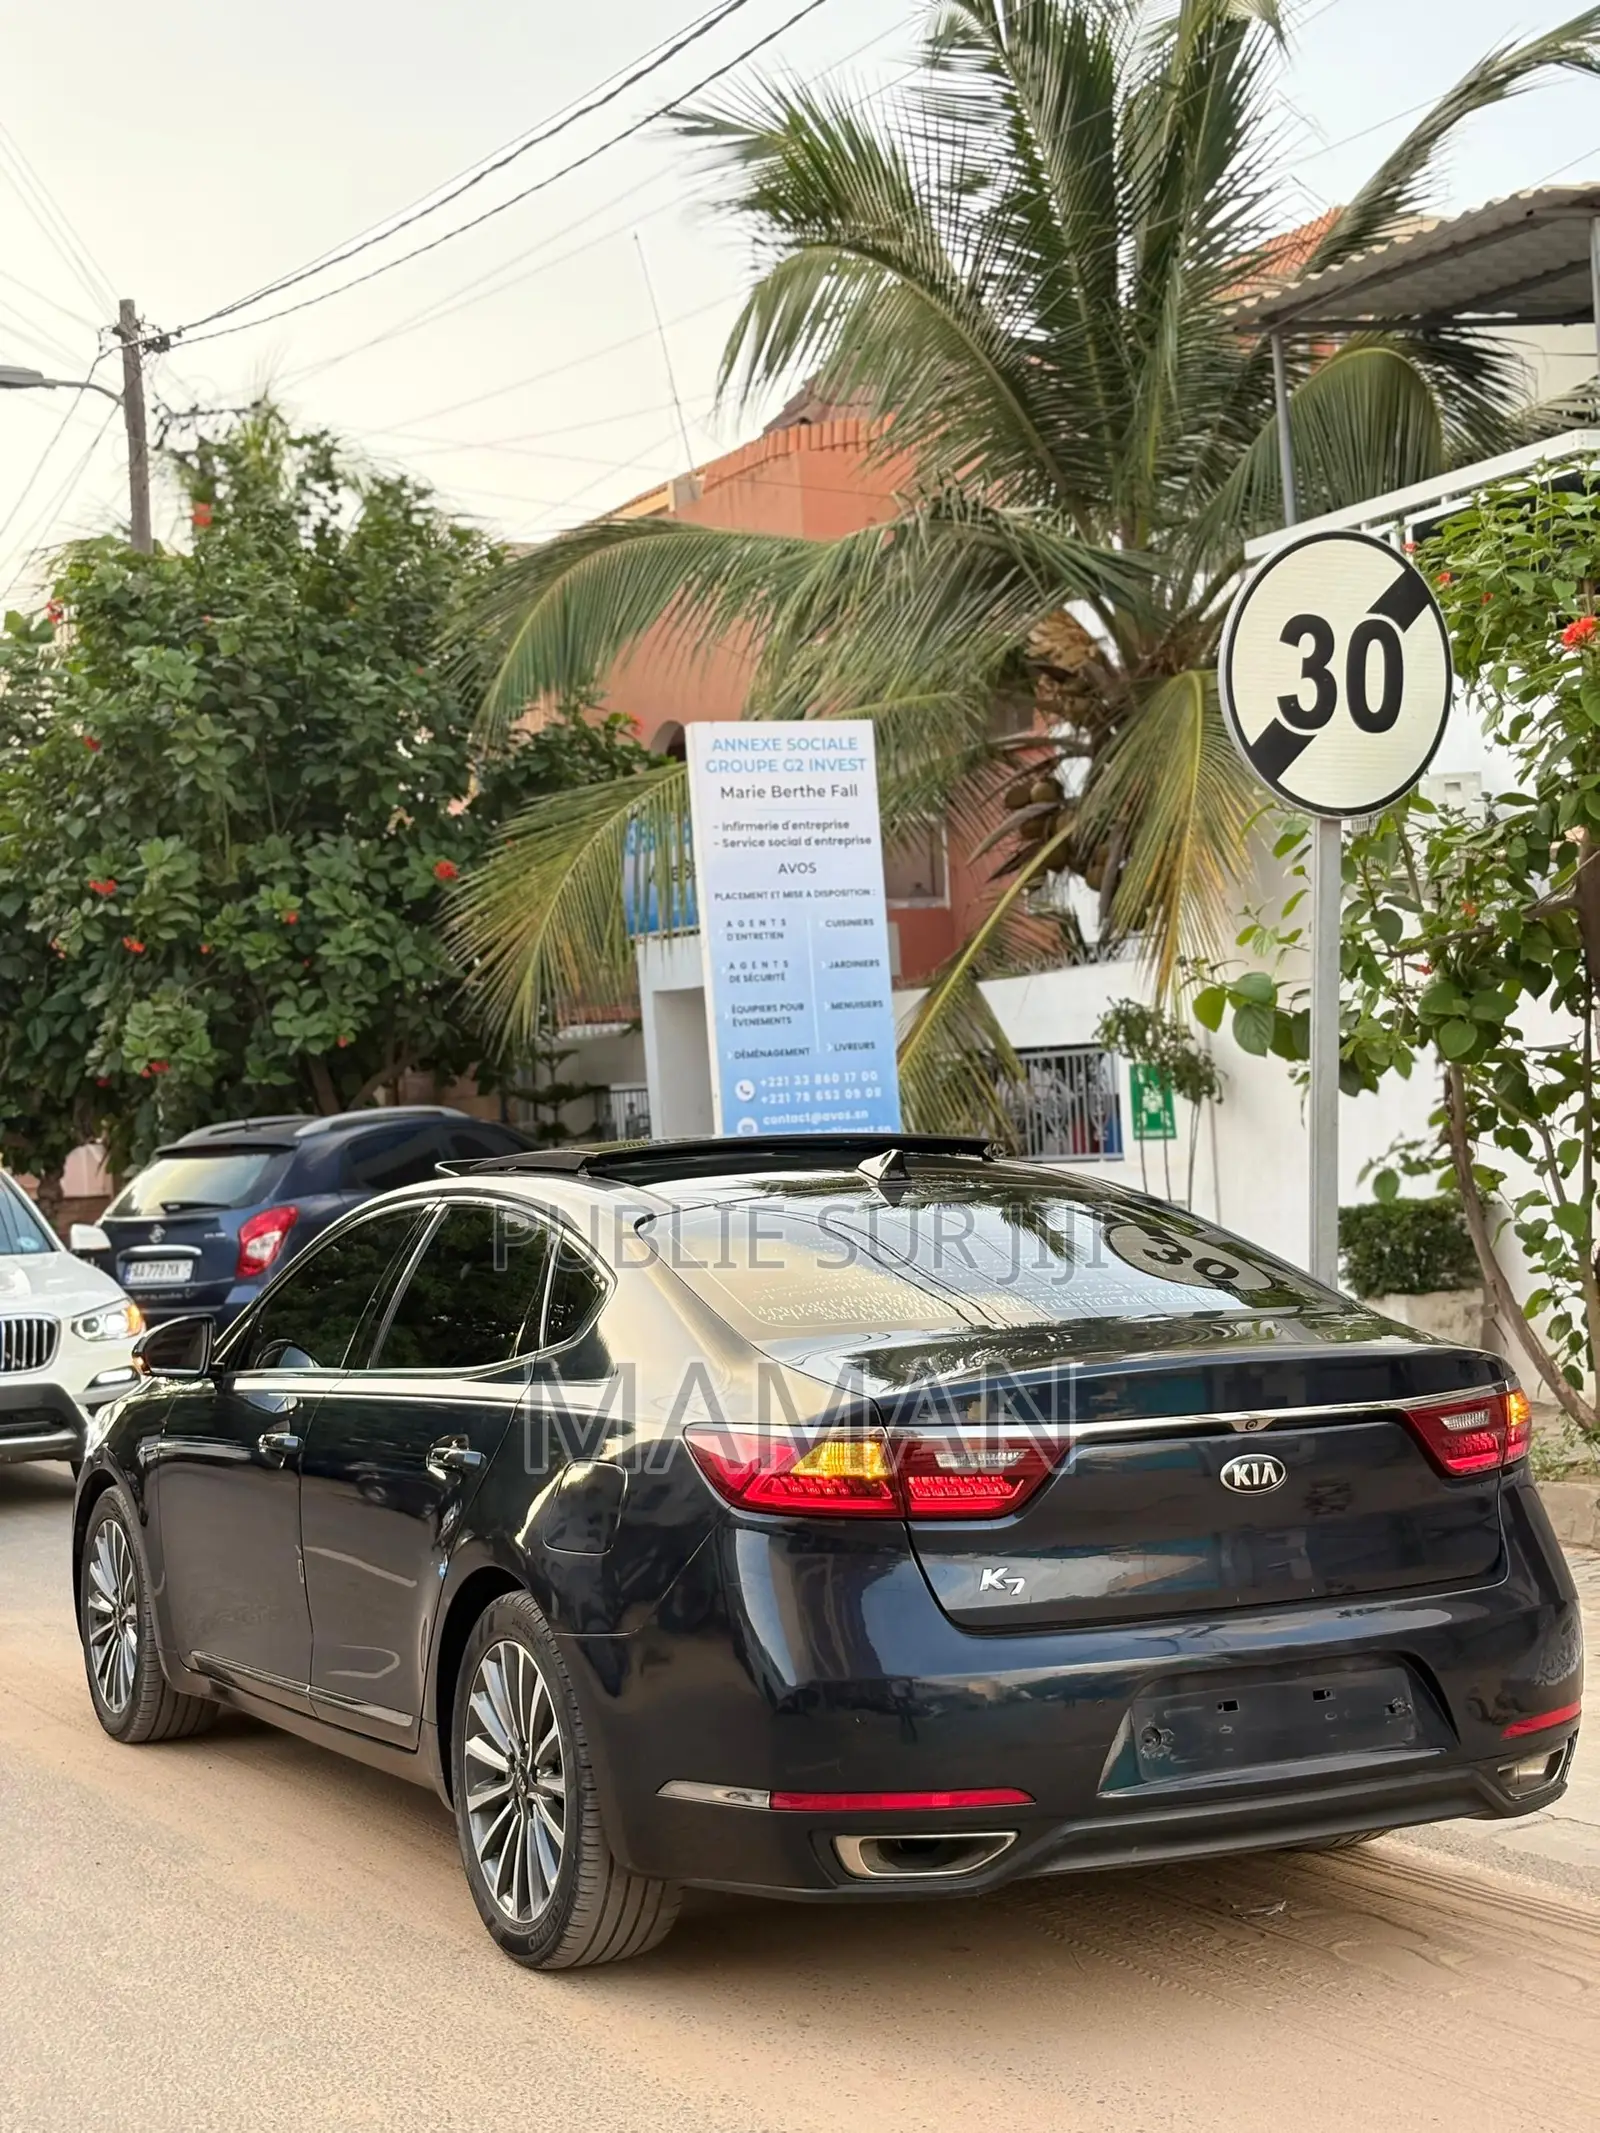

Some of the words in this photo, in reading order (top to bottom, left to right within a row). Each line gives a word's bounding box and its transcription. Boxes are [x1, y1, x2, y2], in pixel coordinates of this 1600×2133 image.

[1277, 613, 1404, 734] 30
[712, 737, 782, 753] ANNEXE
[787, 736, 858, 751] SOCIALE
[705, 758, 779, 774] GROUPE
[783, 758, 804, 773] G2
[809, 757, 867, 772] INVEST
[720, 785, 766, 800] Marie
[771, 784, 826, 799] Berthe
[831, 783, 858, 797] Fall
[722, 837, 766, 849] Service
[768, 835, 802, 847] social
[777, 862, 817, 875] AVOS
[714, 891, 768, 901] PLACEMENT
[771, 891, 780, 899] ET
[782, 890, 803, 899] MISE
[814, 888, 871, 898] DISPOSITION
[825, 918, 875, 928] CUISINIERS
[828, 959, 881, 970] JARDINIERS
[729, 973, 741, 984] DE
[743, 971, 786, 983] SÉCURITÉ
[780, 1003, 804, 1013] POUR
[830, 999, 884, 1010] MENUISIERS
[833, 1041, 876, 1052] LIVREURS
[760, 1076, 789, 1088] +221
[761, 1092, 790, 1105] +221
[1231, 1461, 1279, 1488] KIA
[978, 1567, 1027, 1596] K7
